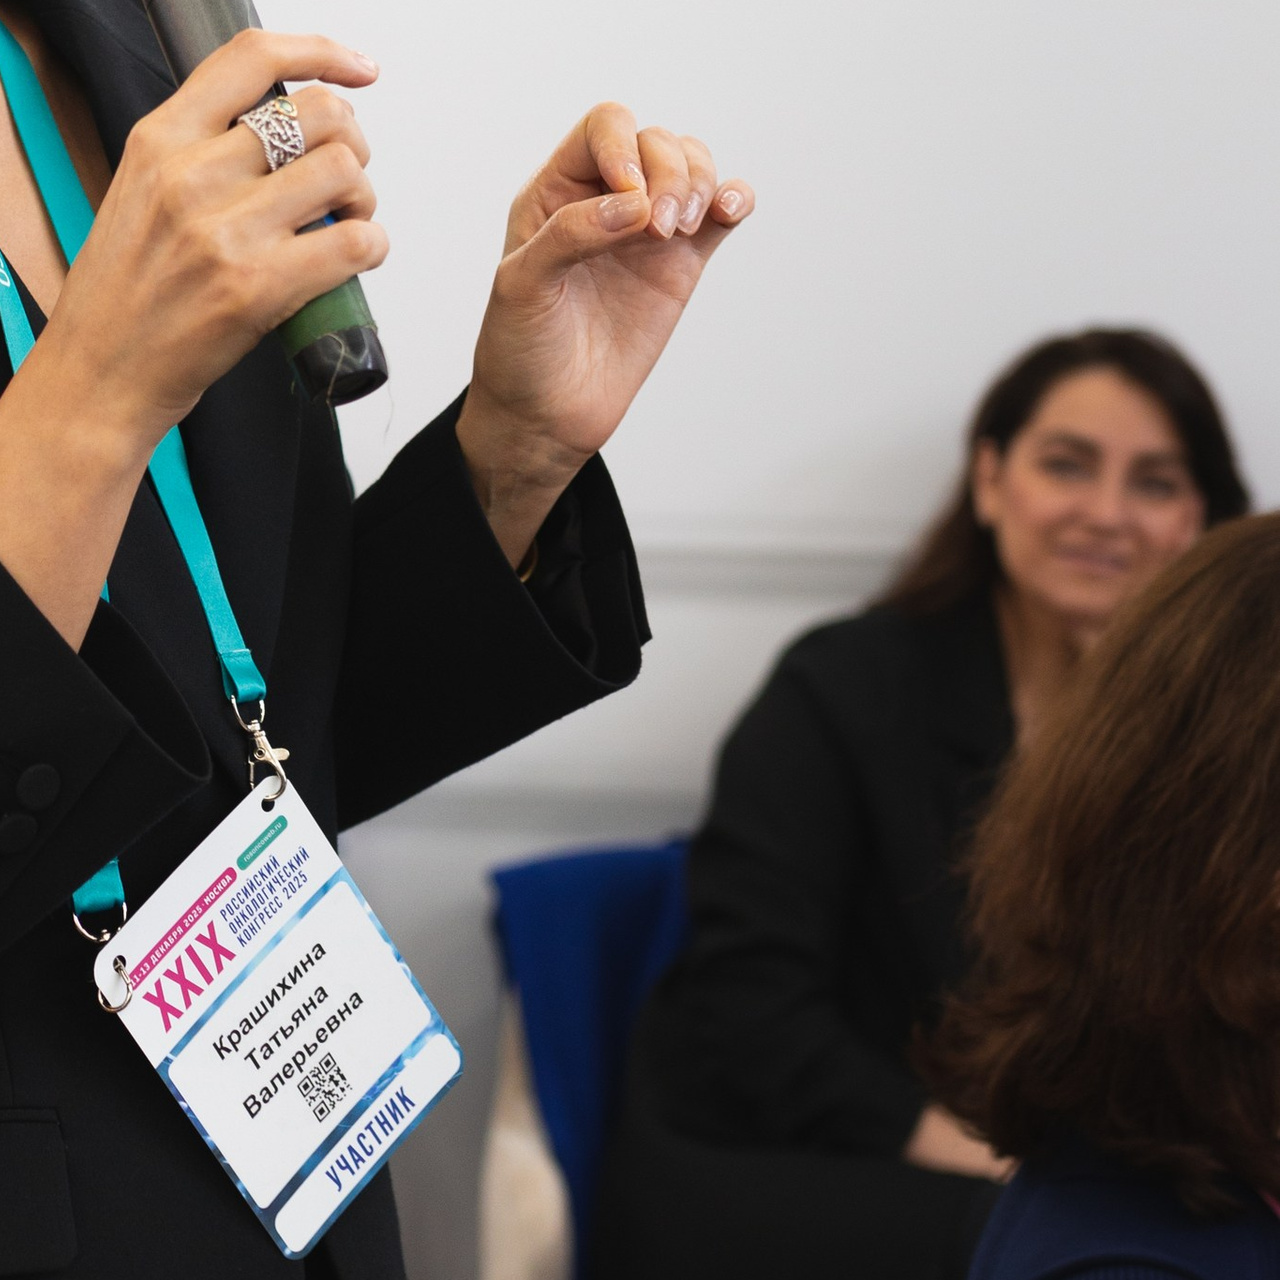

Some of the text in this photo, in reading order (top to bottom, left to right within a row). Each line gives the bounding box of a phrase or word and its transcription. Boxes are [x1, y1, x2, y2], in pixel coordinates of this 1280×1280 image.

[243, 822, 282, 862] rosoncoweb.ru
[150, 927, 184, 965] ДЕКАБРЯ
[183, 905, 202, 927] 2025
[204, 874, 233, 906] МОСКВА
[220, 854, 280, 922] РОССИЙСКИЙ
[228, 846, 310, 934] ОНКОЛОГИЧЕСКИЙ
[237, 870, 308, 948] КОНГРЕСС 2025
[142, 920, 236, 1034] XXIX
[212, 942, 327, 1060] Крашихина
[242, 991, 364, 1119] Валерьевна
[244, 986, 329, 1070] Татьяна
[325, 1086, 416, 1191] УЧАСТНИК
